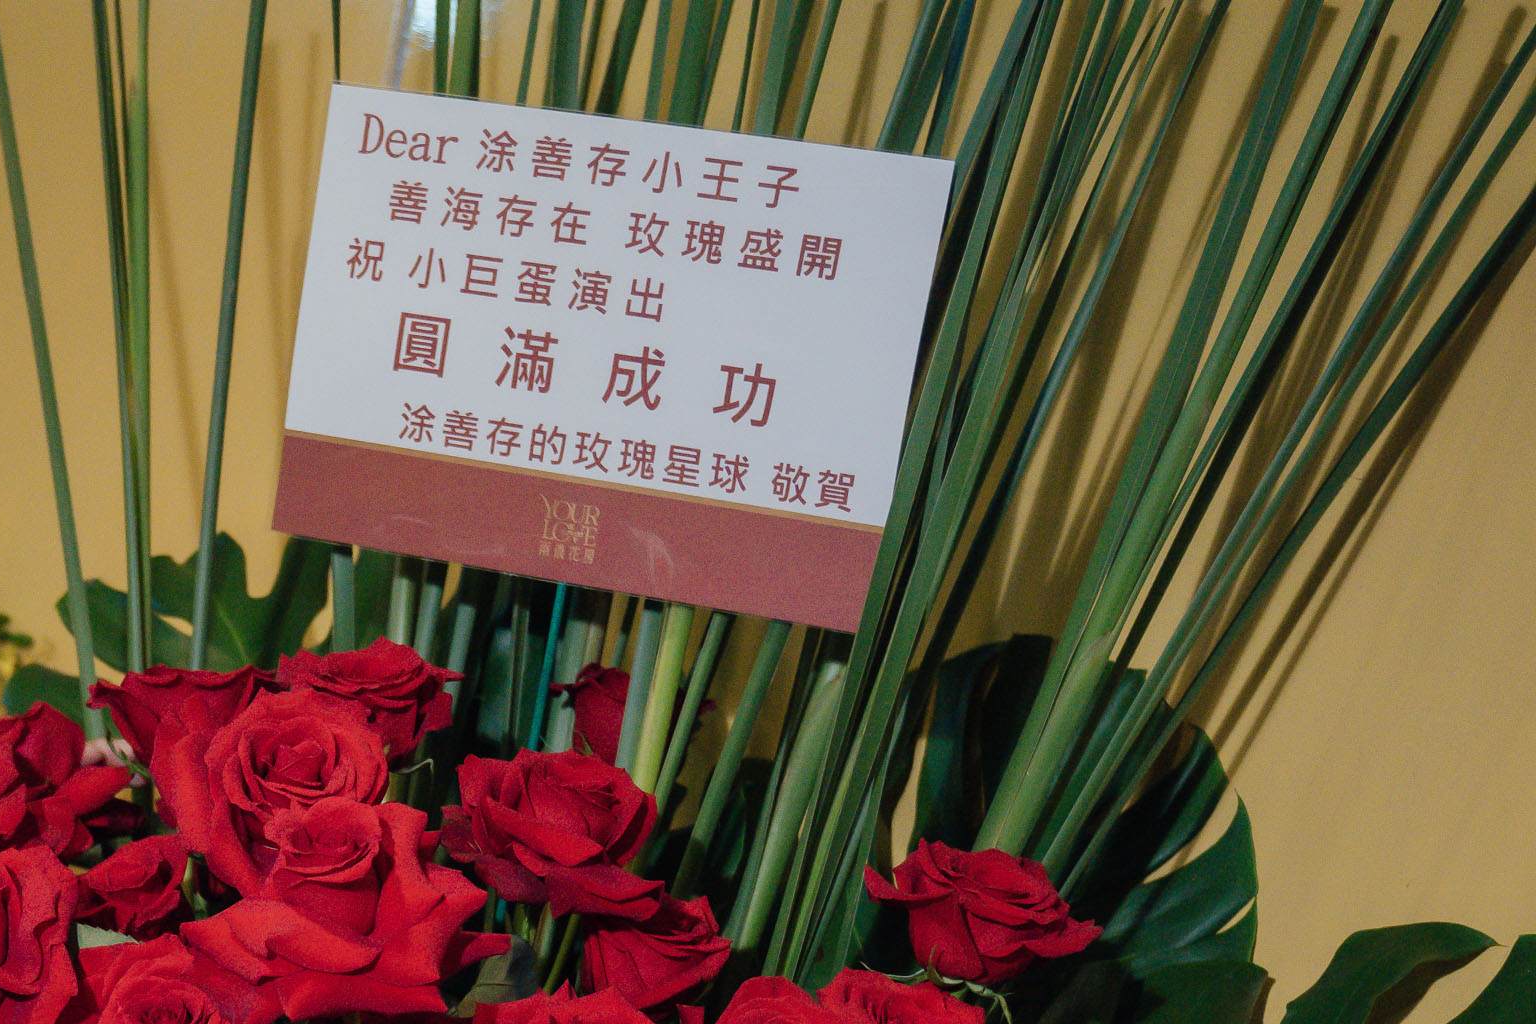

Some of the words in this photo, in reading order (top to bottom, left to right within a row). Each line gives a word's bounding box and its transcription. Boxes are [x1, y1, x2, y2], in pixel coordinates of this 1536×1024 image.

[359, 113, 459, 165] Dear
[476, 128, 800, 209] 涂善存小王子
[388, 180, 591, 245] 善海存在
[625, 212, 842, 281] 玫瑰盛開
[346, 237, 385, 282] 祝
[408, 247, 665, 323] 小巨蛋演出
[399, 402, 750, 494] 涂善存的玫瑰星球
[771, 463, 855, 513] 敬賀
[539, 493, 601, 526] YOUR
